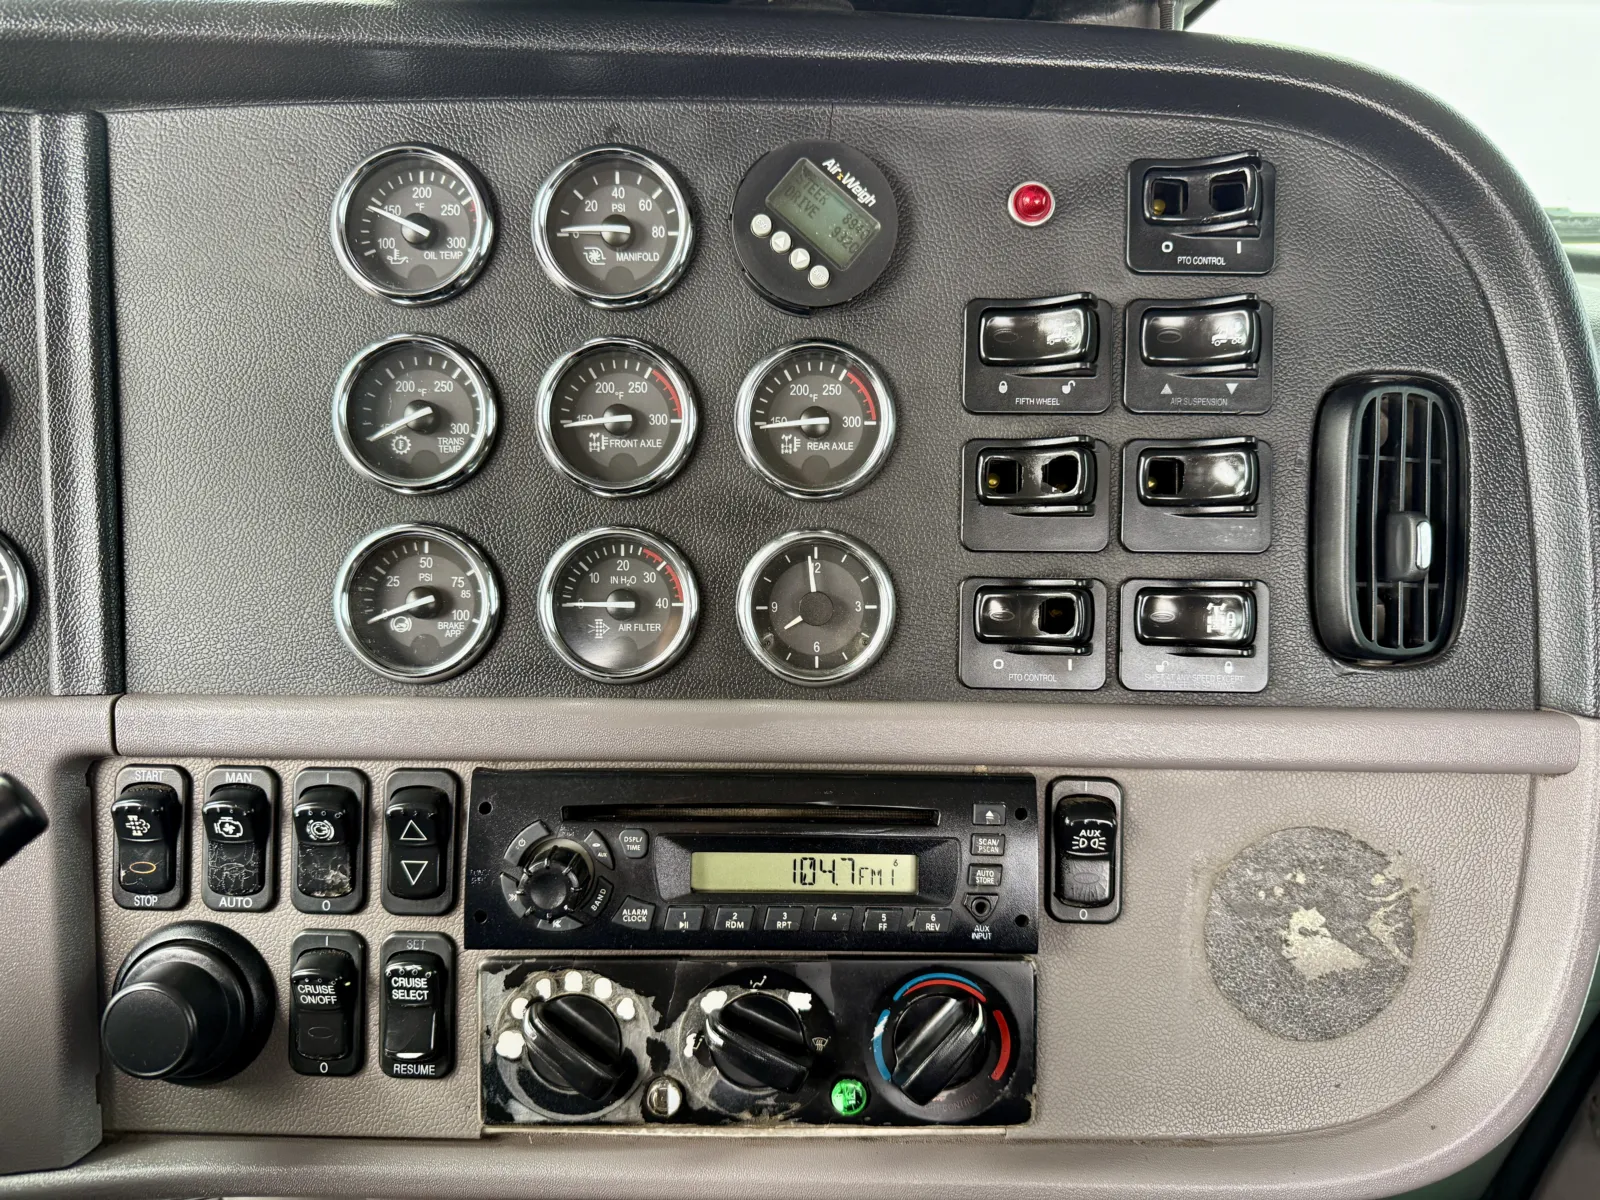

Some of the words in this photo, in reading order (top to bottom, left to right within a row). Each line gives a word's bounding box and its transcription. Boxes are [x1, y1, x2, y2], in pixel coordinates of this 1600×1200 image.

[412, 187, 432, 198] 200
[611, 187, 625, 199] 40
[584, 200, 598, 212] 20
[612, 203, 625, 212] PSI
[638, 200, 652, 211] 60
[784, 186, 820, 219] DRIVE
[384, 205, 401, 216] 150
[441, 205, 460, 216] 250
[652, 226, 665, 238] 80
[378, 238, 395, 249] 100
[447, 237, 466, 249] 300
[424, 252, 437, 260] OIL
[616, 253, 659, 262] MANIFOLD
[1178, 256, 1192, 265] PTO
[1193, 257, 1226, 265] CONTROL
[396, 381, 415, 392] 200
[434, 381, 453, 392] 250
[595, 382, 615, 393] 200
[628, 382, 648, 393] 250
[790, 384, 809, 396] 200
[822, 384, 842, 395] 250
[649, 414, 668, 425] 300
[842, 417, 861, 428] 300
[451, 424, 469, 434] 300
[609, 439, 638, 448] FRONT
[419, 557, 433, 568] 50
[617, 560, 629, 571] 20
[387, 576, 400, 587] 25
[419, 573, 433, 582] PSI
[451, 577, 464, 588] 75
[589, 572, 599, 583] 10
[643, 572, 656, 583] 30
[461, 590, 471, 599] 85
[655, 598, 668, 609] 40
[771, 602, 778, 612] 9
[855, 601, 862, 612] 3
[452, 610, 470, 621] 100
[438, 622, 464, 630] BRAKE
[813, 642, 820, 652] 6
[135, 770, 164, 781] START
[226, 772, 252, 783] MAN
[793, 857, 855, 885] 104.7
[134, 896, 158, 906] STOP
[219, 898, 252, 908] AUTO
[591, 888, 606, 912] BAND
[406, 940, 426, 949] SET
[391, 977, 428, 988] CRUISE
[298, 985, 336, 994] CRUISE
[392, 990, 429, 1000] SELECT
[300, 995, 337, 1005] ON/OFF
[393, 1064, 435, 1075] RESUME
